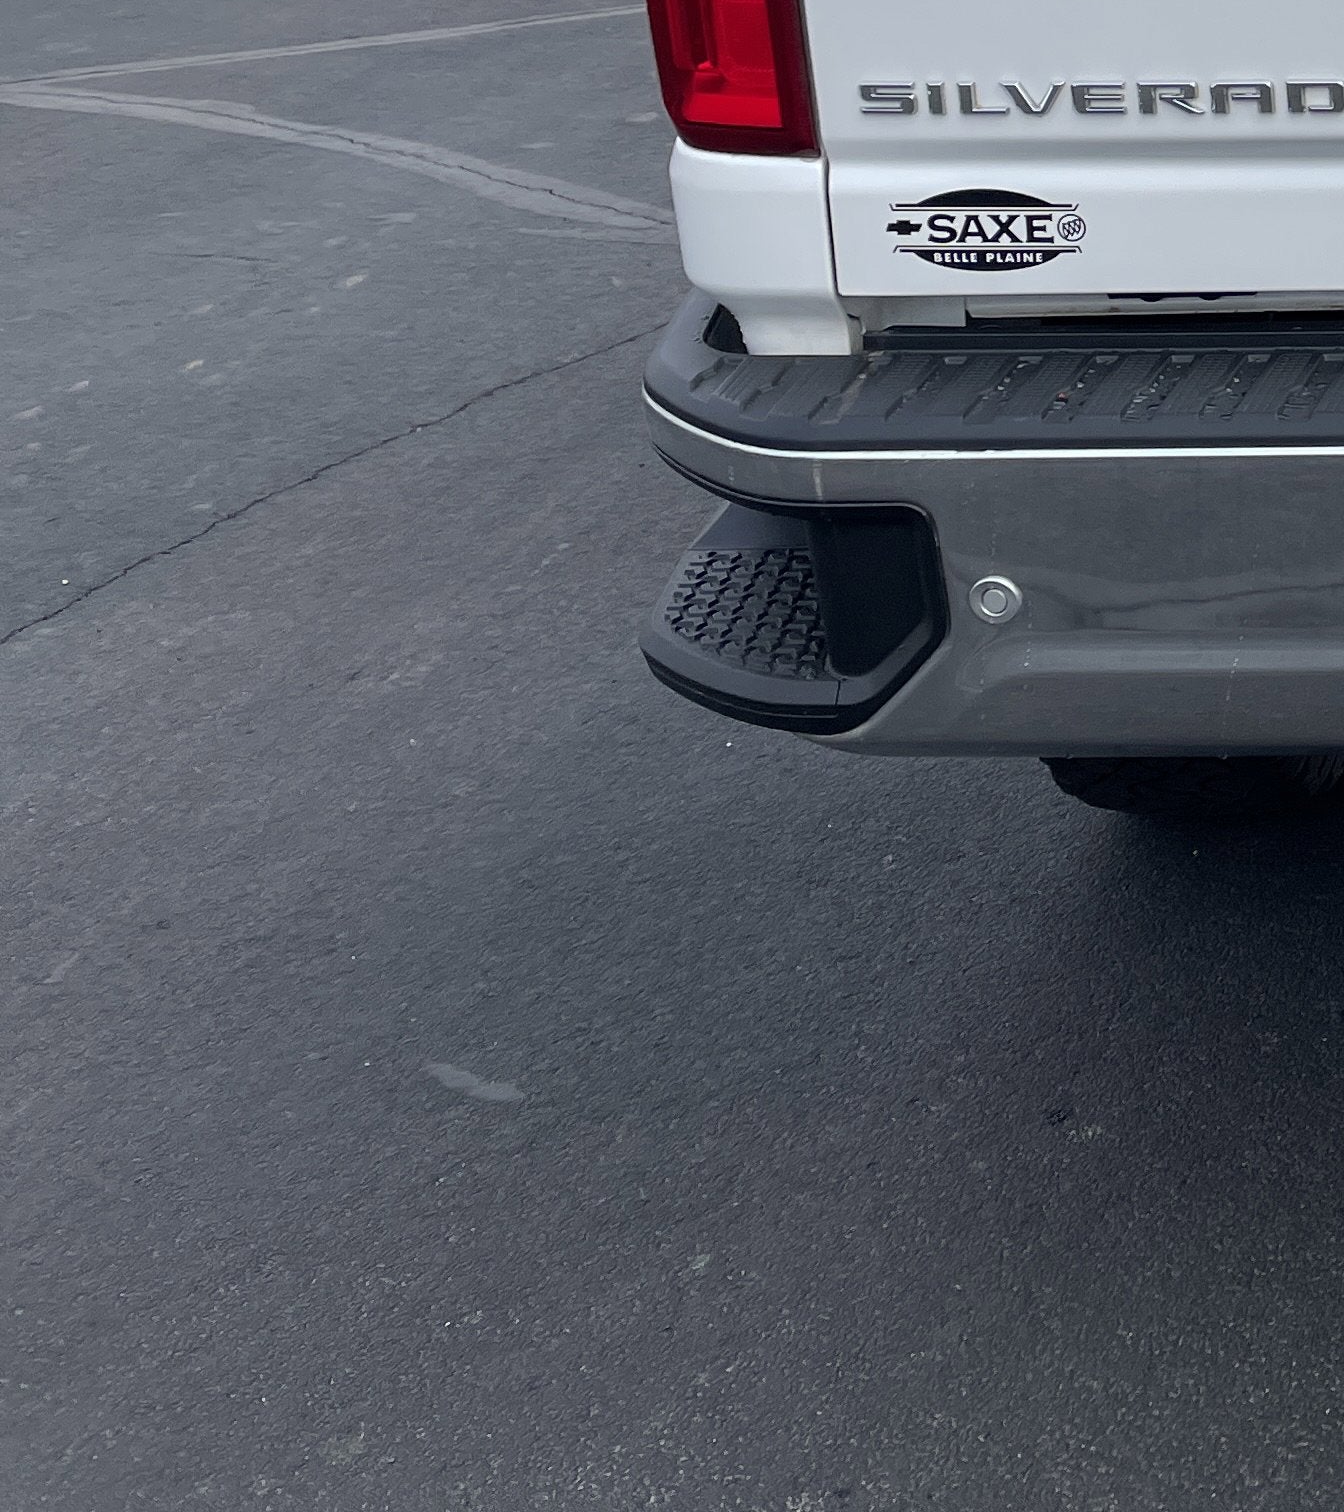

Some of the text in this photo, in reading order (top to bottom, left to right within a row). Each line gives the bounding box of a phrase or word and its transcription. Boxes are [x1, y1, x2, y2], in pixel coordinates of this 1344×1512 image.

[926, 213, 1055, 244] SAXE
[933, 252, 1044, 264] BELLE PLAINE
